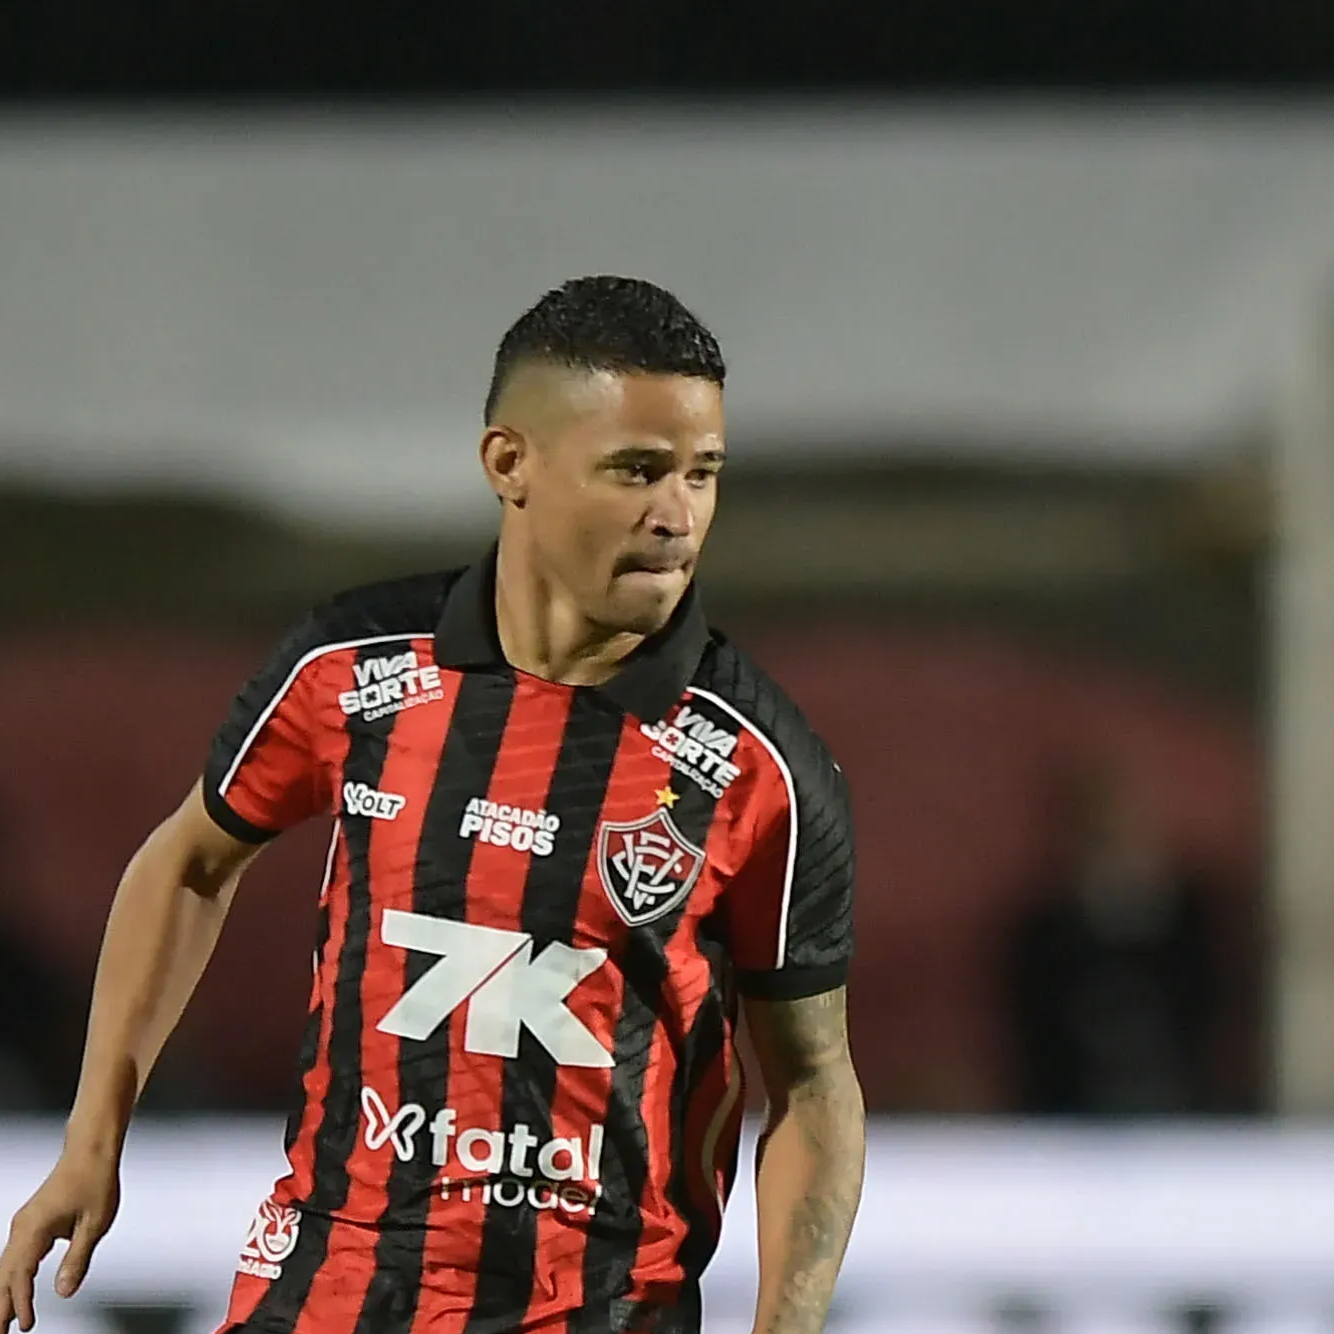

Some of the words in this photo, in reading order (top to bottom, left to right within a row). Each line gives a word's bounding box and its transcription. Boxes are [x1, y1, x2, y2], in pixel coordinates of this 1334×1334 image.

[338, 665, 442, 714] SORTE
[352, 651, 418, 687] VIVA
[673, 706, 738, 758] VIVA
[459, 814, 555, 856] PISOS
[466, 798, 560, 832] ATACADÃO
[376, 908, 616, 1068] 7K
[429, 1108, 605, 1181] fatal
